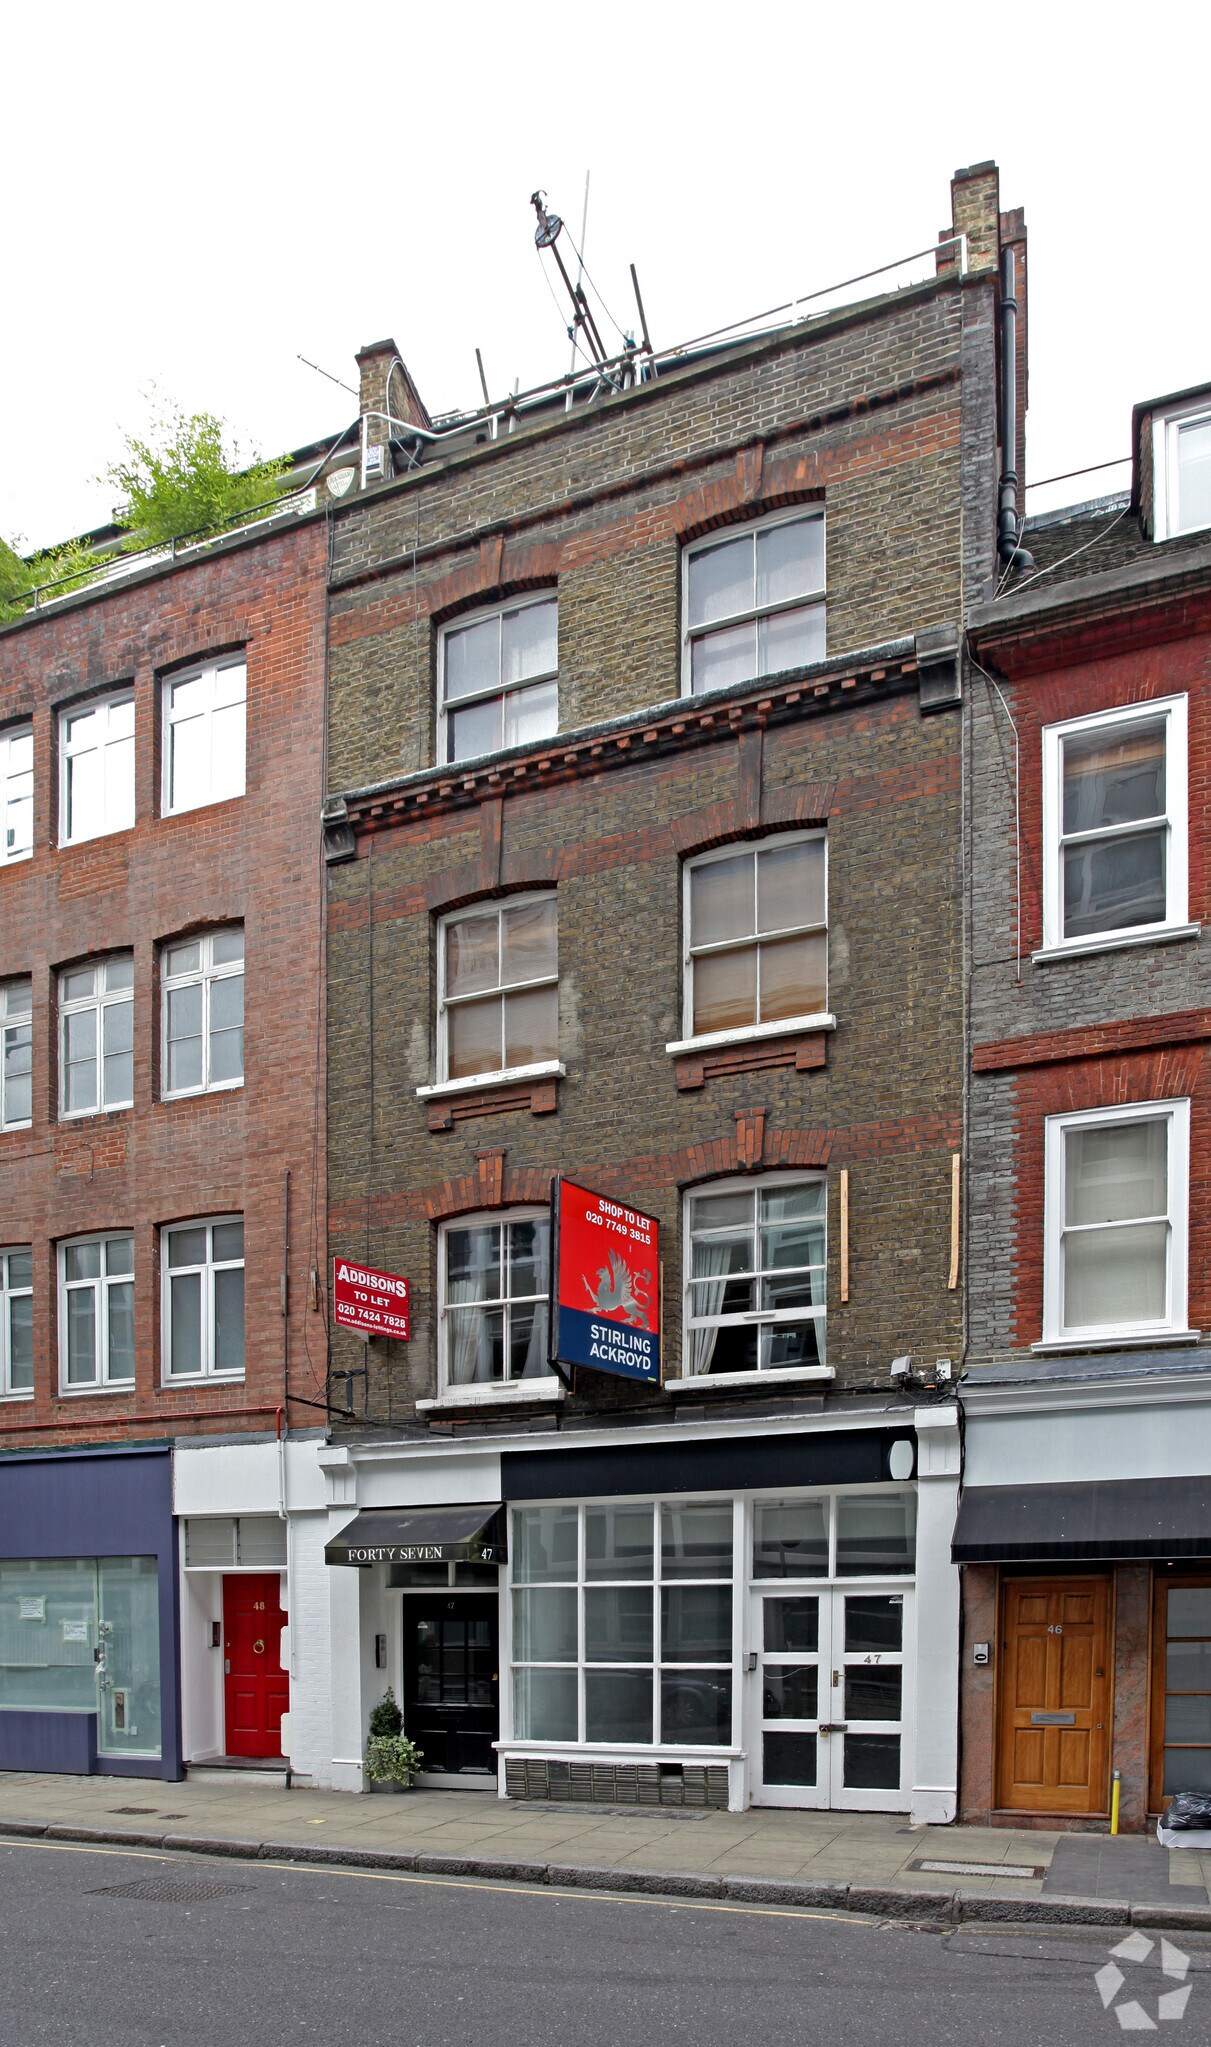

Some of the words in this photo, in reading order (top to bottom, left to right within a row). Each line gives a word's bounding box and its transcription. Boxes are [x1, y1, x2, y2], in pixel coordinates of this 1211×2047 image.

[599, 1200, 624, 1222] SHOP
[624, 1209, 635, 1225] TO
[636, 1214, 651, 1231] LET
[586, 1211, 603, 1227] 020
[605, 1218, 628, 1236] 7749
[629, 1227, 651, 1245] 3815
[338, 1265, 406, 1297] ADDISONS
[354, 1290, 368, 1301] TO
[371, 1295, 390, 1307] LET
[338, 1303, 355, 1316] 020
[358, 1308, 381, 1322] 7424
[383, 1315, 406, 1329] 7828
[590, 1324, 651, 1354] STIRLING
[589, 1342, 651, 1371] ACKROYD
[347, 1548, 395, 1561] FORTY
[399, 1546, 442, 1560] SEVEN
[481, 1547, 493, 1560] 47
[253, 1601, 265, 1610] 48
[1048, 1625, 1062, 1634] 46
[864, 1655, 881, 1664] 47
